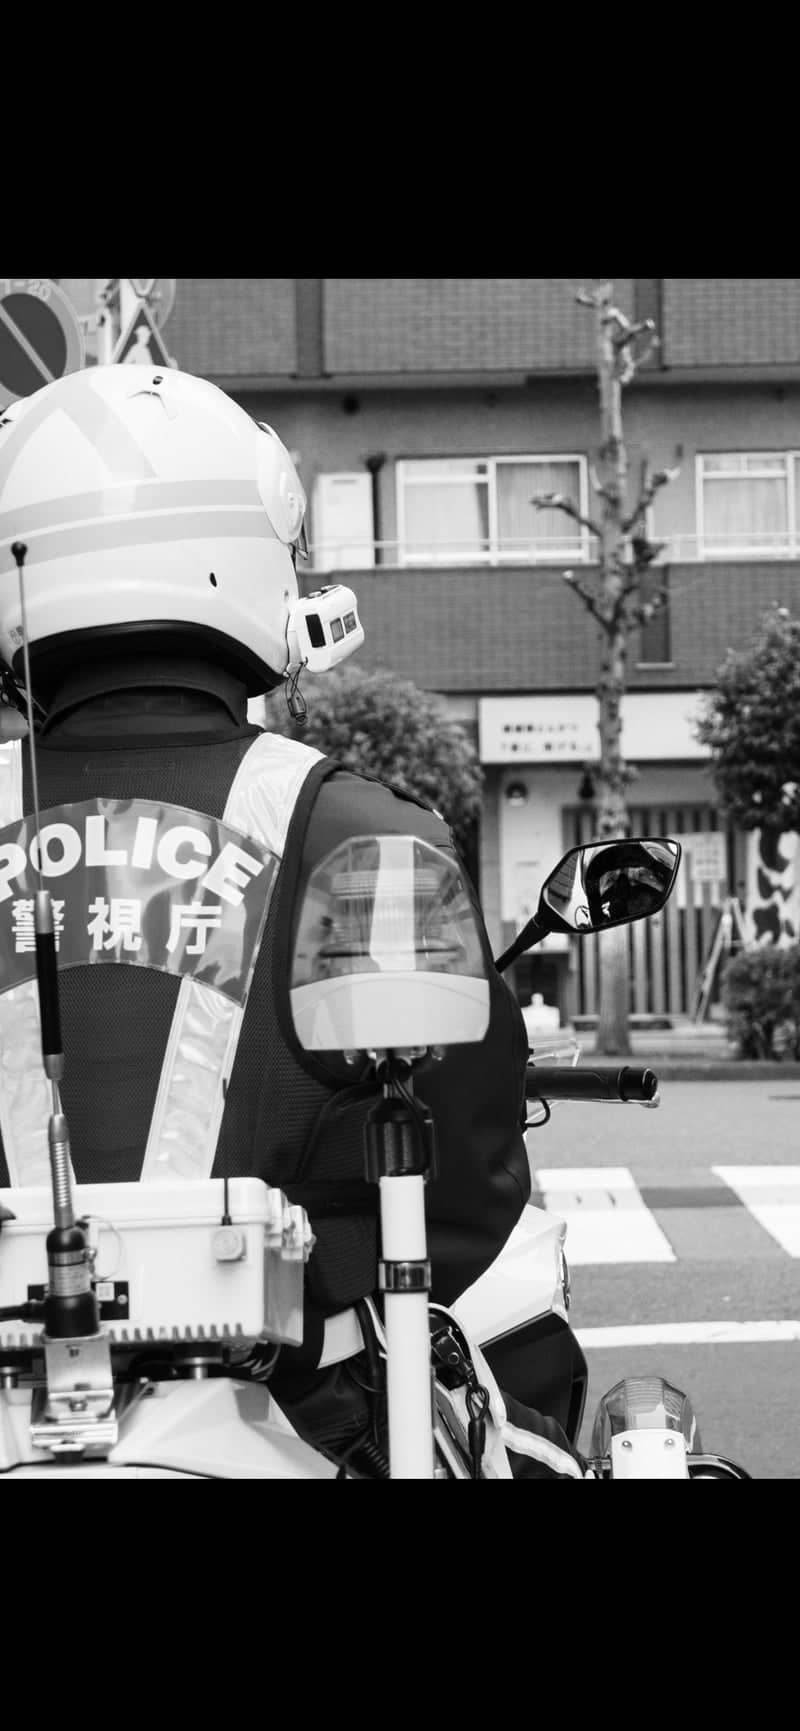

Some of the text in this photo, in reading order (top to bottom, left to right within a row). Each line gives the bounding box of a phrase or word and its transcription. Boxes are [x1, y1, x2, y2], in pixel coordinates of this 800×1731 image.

[0, 815, 265, 906] POLICE
[11, 896, 223, 955] 警視庁
